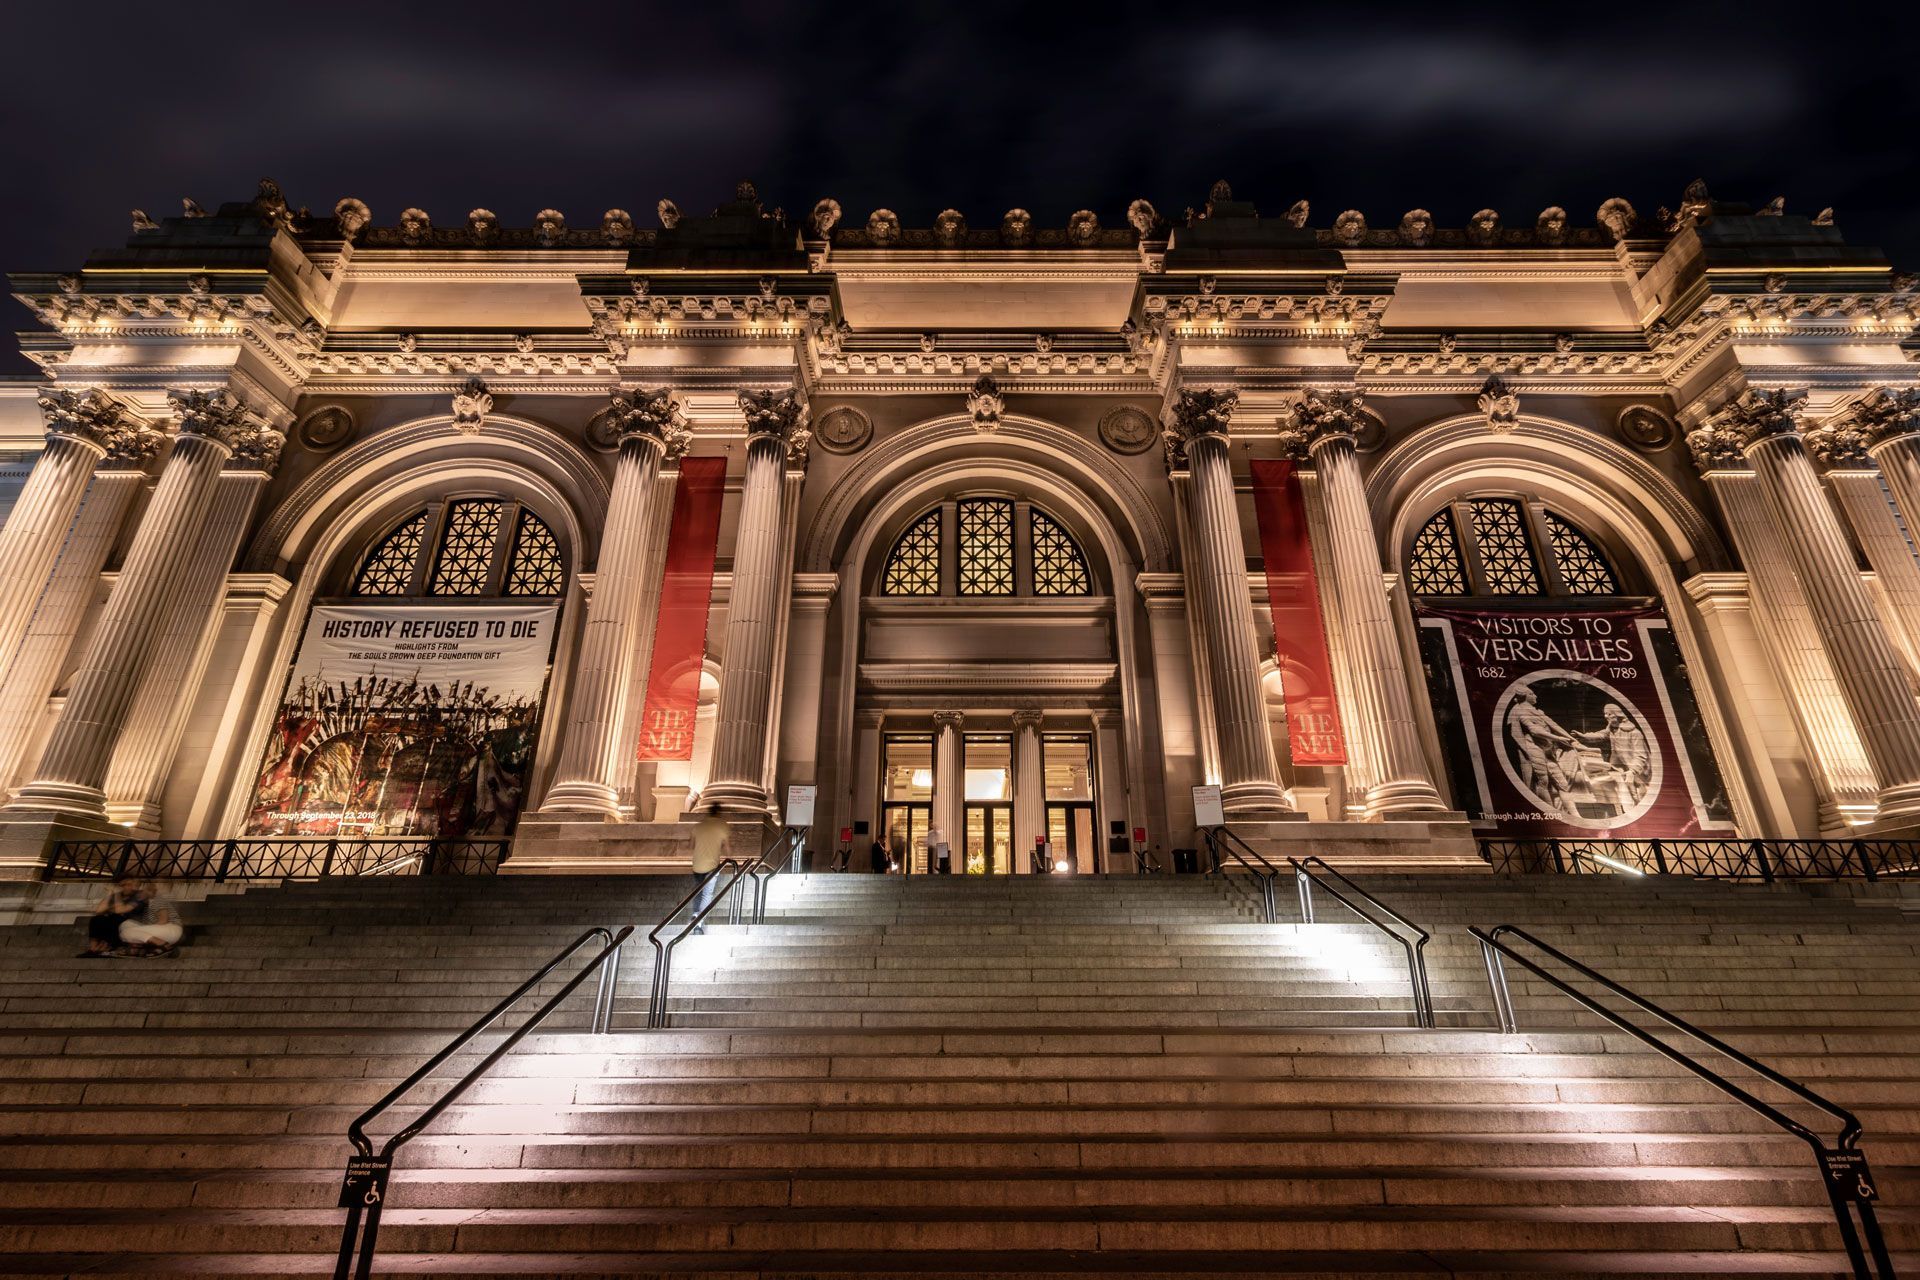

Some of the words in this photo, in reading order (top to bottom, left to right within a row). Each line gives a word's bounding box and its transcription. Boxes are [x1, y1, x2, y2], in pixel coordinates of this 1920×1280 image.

[322, 620, 397, 638] HISTORY
[399, 620, 480, 638] REFUSED
[485, 620, 506, 638] TO
[509, 620, 540, 638] DIE
[1476, 617, 1574, 635] VISITORS
[1578, 617, 1612, 635] TO
[394, 643, 437, 651] HIGHLIGHTS
[437, 643, 459, 651] FROM
[1468, 638, 1634, 662] VERSAILLES
[348, 652, 363, 660] THE
[363, 652, 387, 660] SOULS
[388, 652, 417, 660] GROWN
[416, 652, 437, 660] DEEP
[437, 652, 483, 660] FOUNDATION
[484, 652, 502, 660] GIFT
[1477, 667, 1507, 679] 1682
[1609, 667, 1638, 679] 1789
[644, 730, 688, 751] MET
[1296, 734, 1338, 755] MET
[266, 811, 299, 820] Through
[300, 811, 342, 820] September
[357, 811, 376, 819] 2018
[1478, 812, 1513, 822] Through
[1513, 812, 1530, 822] July
[1530, 812, 1543, 821] 29,
[1543, 812, 1563, 821] 2018
